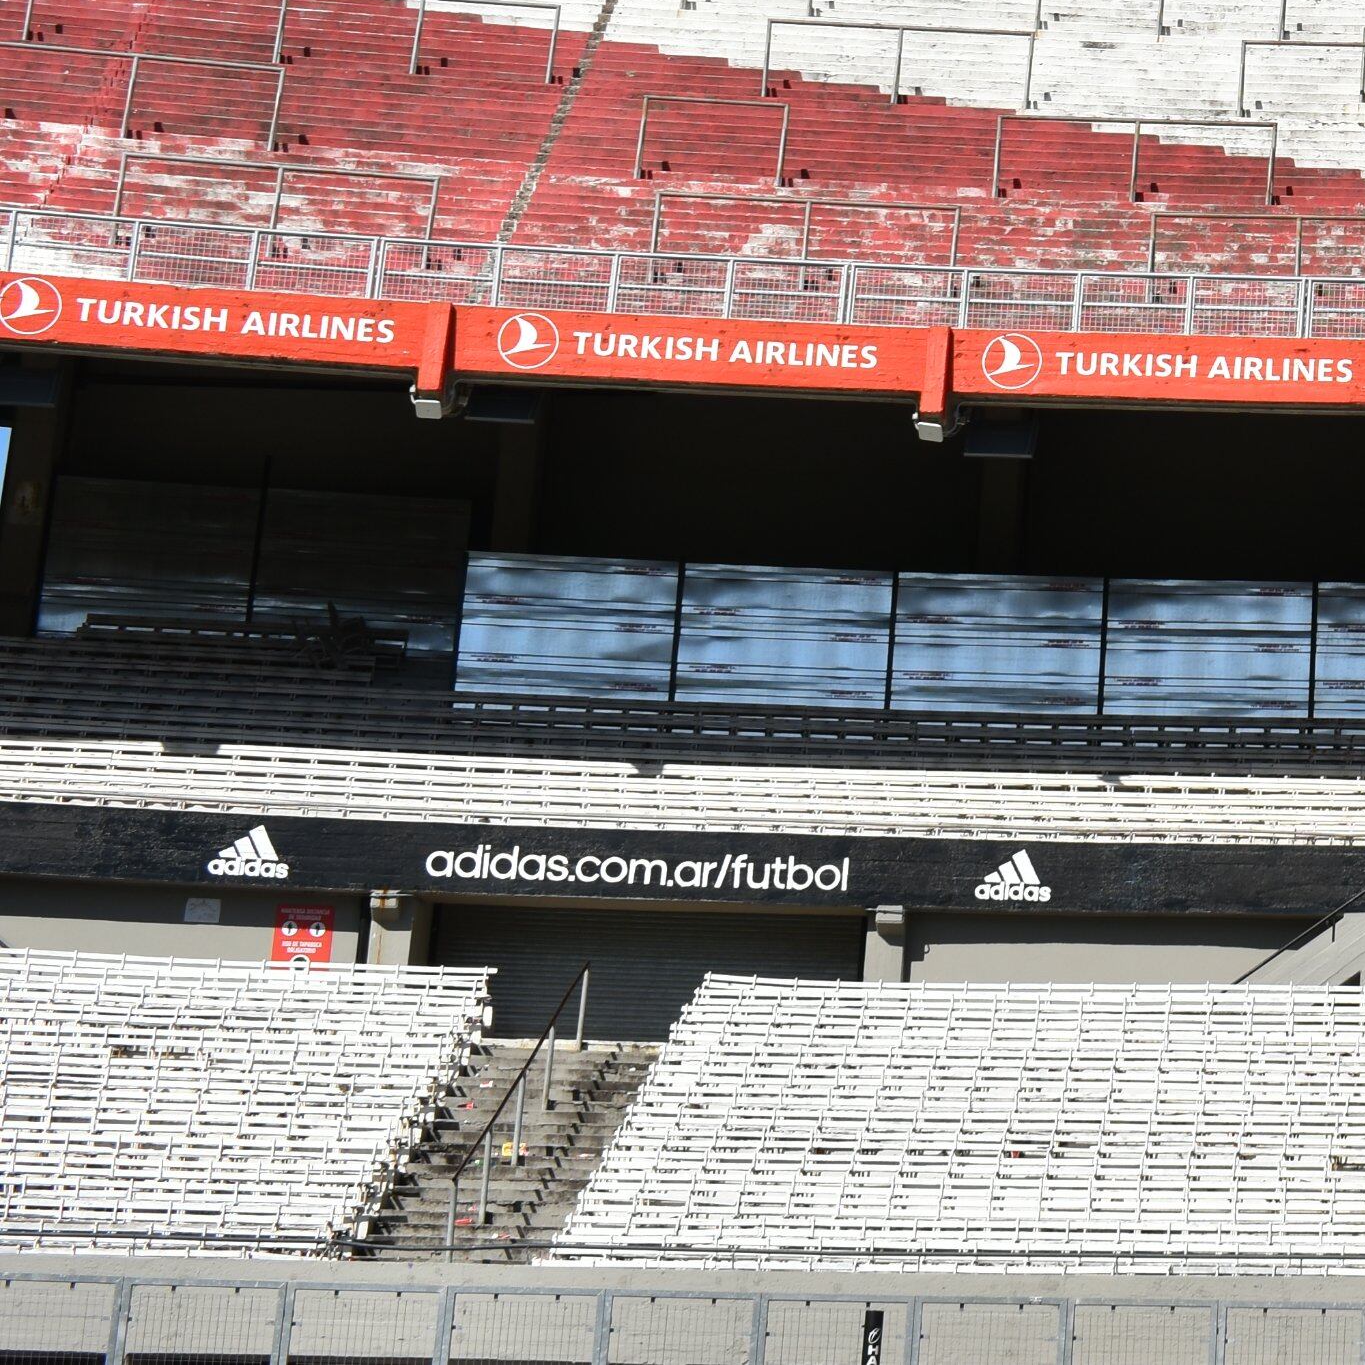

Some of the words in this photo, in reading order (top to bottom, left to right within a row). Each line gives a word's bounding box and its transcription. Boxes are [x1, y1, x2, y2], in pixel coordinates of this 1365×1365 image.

[76, 297, 229, 332] TURKISH
[240, 311, 396, 344] AIRLINES
[572, 331, 720, 362] TURKISH
[728, 340, 878, 369] AIRLINES
[1054, 351, 1199, 379] TURKISH
[1207, 355, 1353, 383] AIRLINES
[207, 857, 289, 879] adidas
[425, 844, 850, 892] adidas.com.ar/futbol
[974, 881, 1052, 902] adidas
